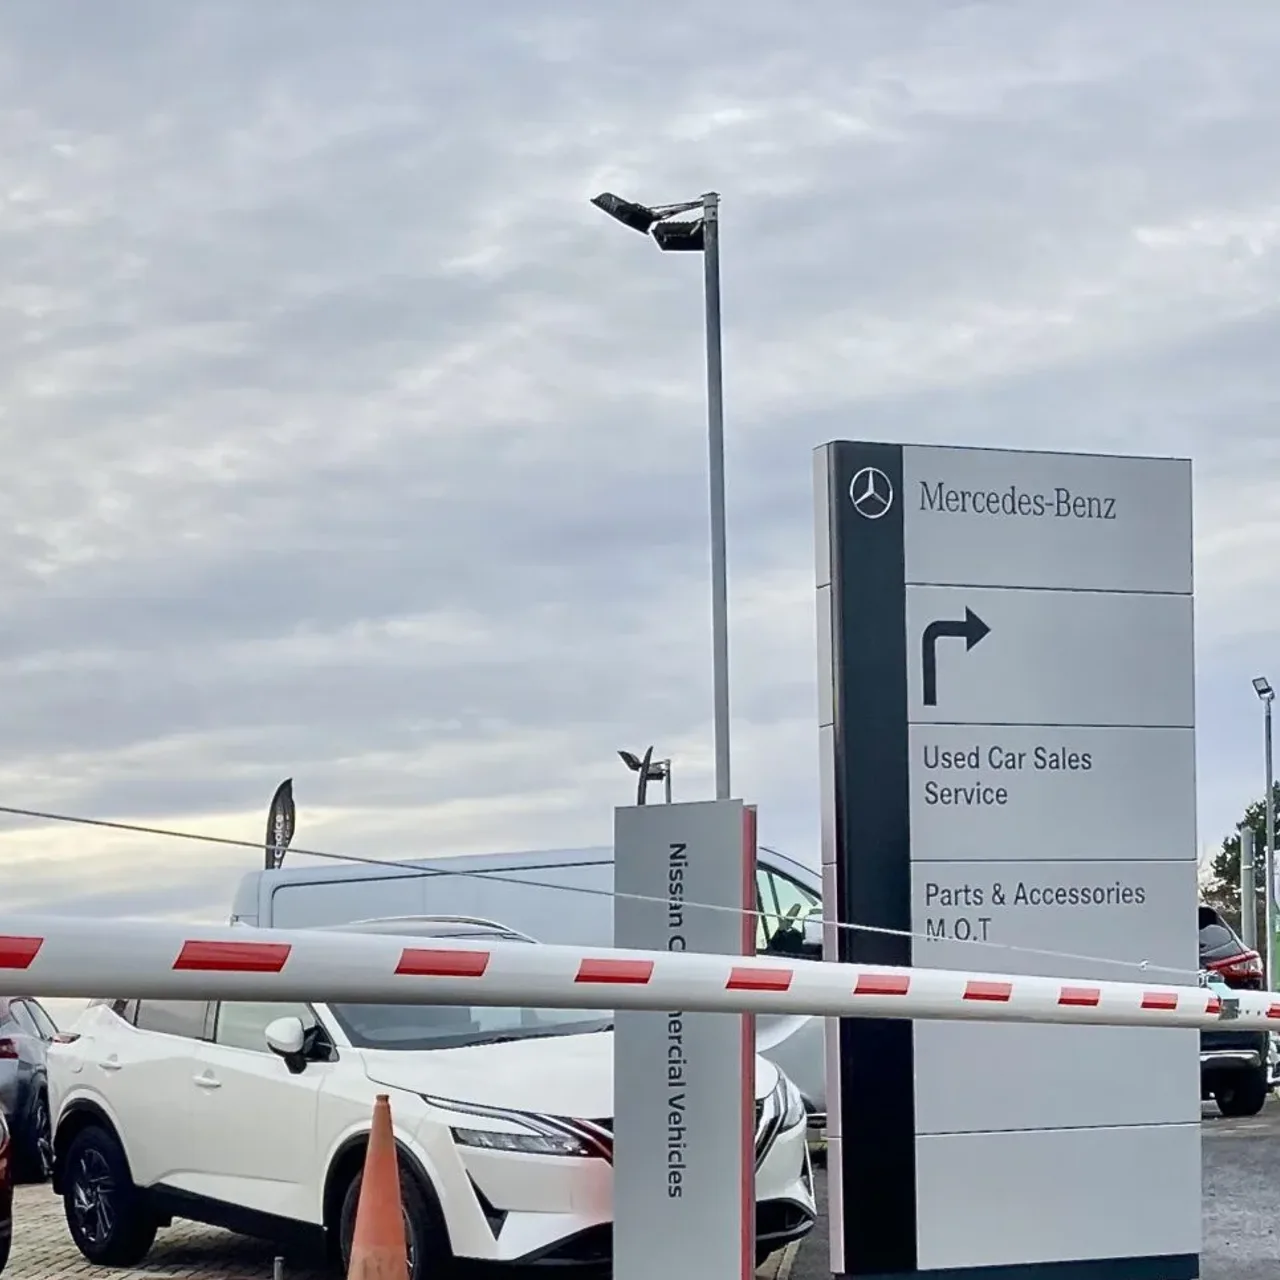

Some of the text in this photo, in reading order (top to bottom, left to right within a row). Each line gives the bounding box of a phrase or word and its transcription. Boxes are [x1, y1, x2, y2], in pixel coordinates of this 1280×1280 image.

[919, 481, 1117, 520] Mercedes-Benz
[923, 745, 1093, 770] Used Car Sales
[924, 780, 1008, 805] Service
[925, 882, 1146, 906] Parts & Accessories
[926, 917, 992, 942] M.O.T
[668, 843, 688, 1198] Nissan Cercial Vehicles
